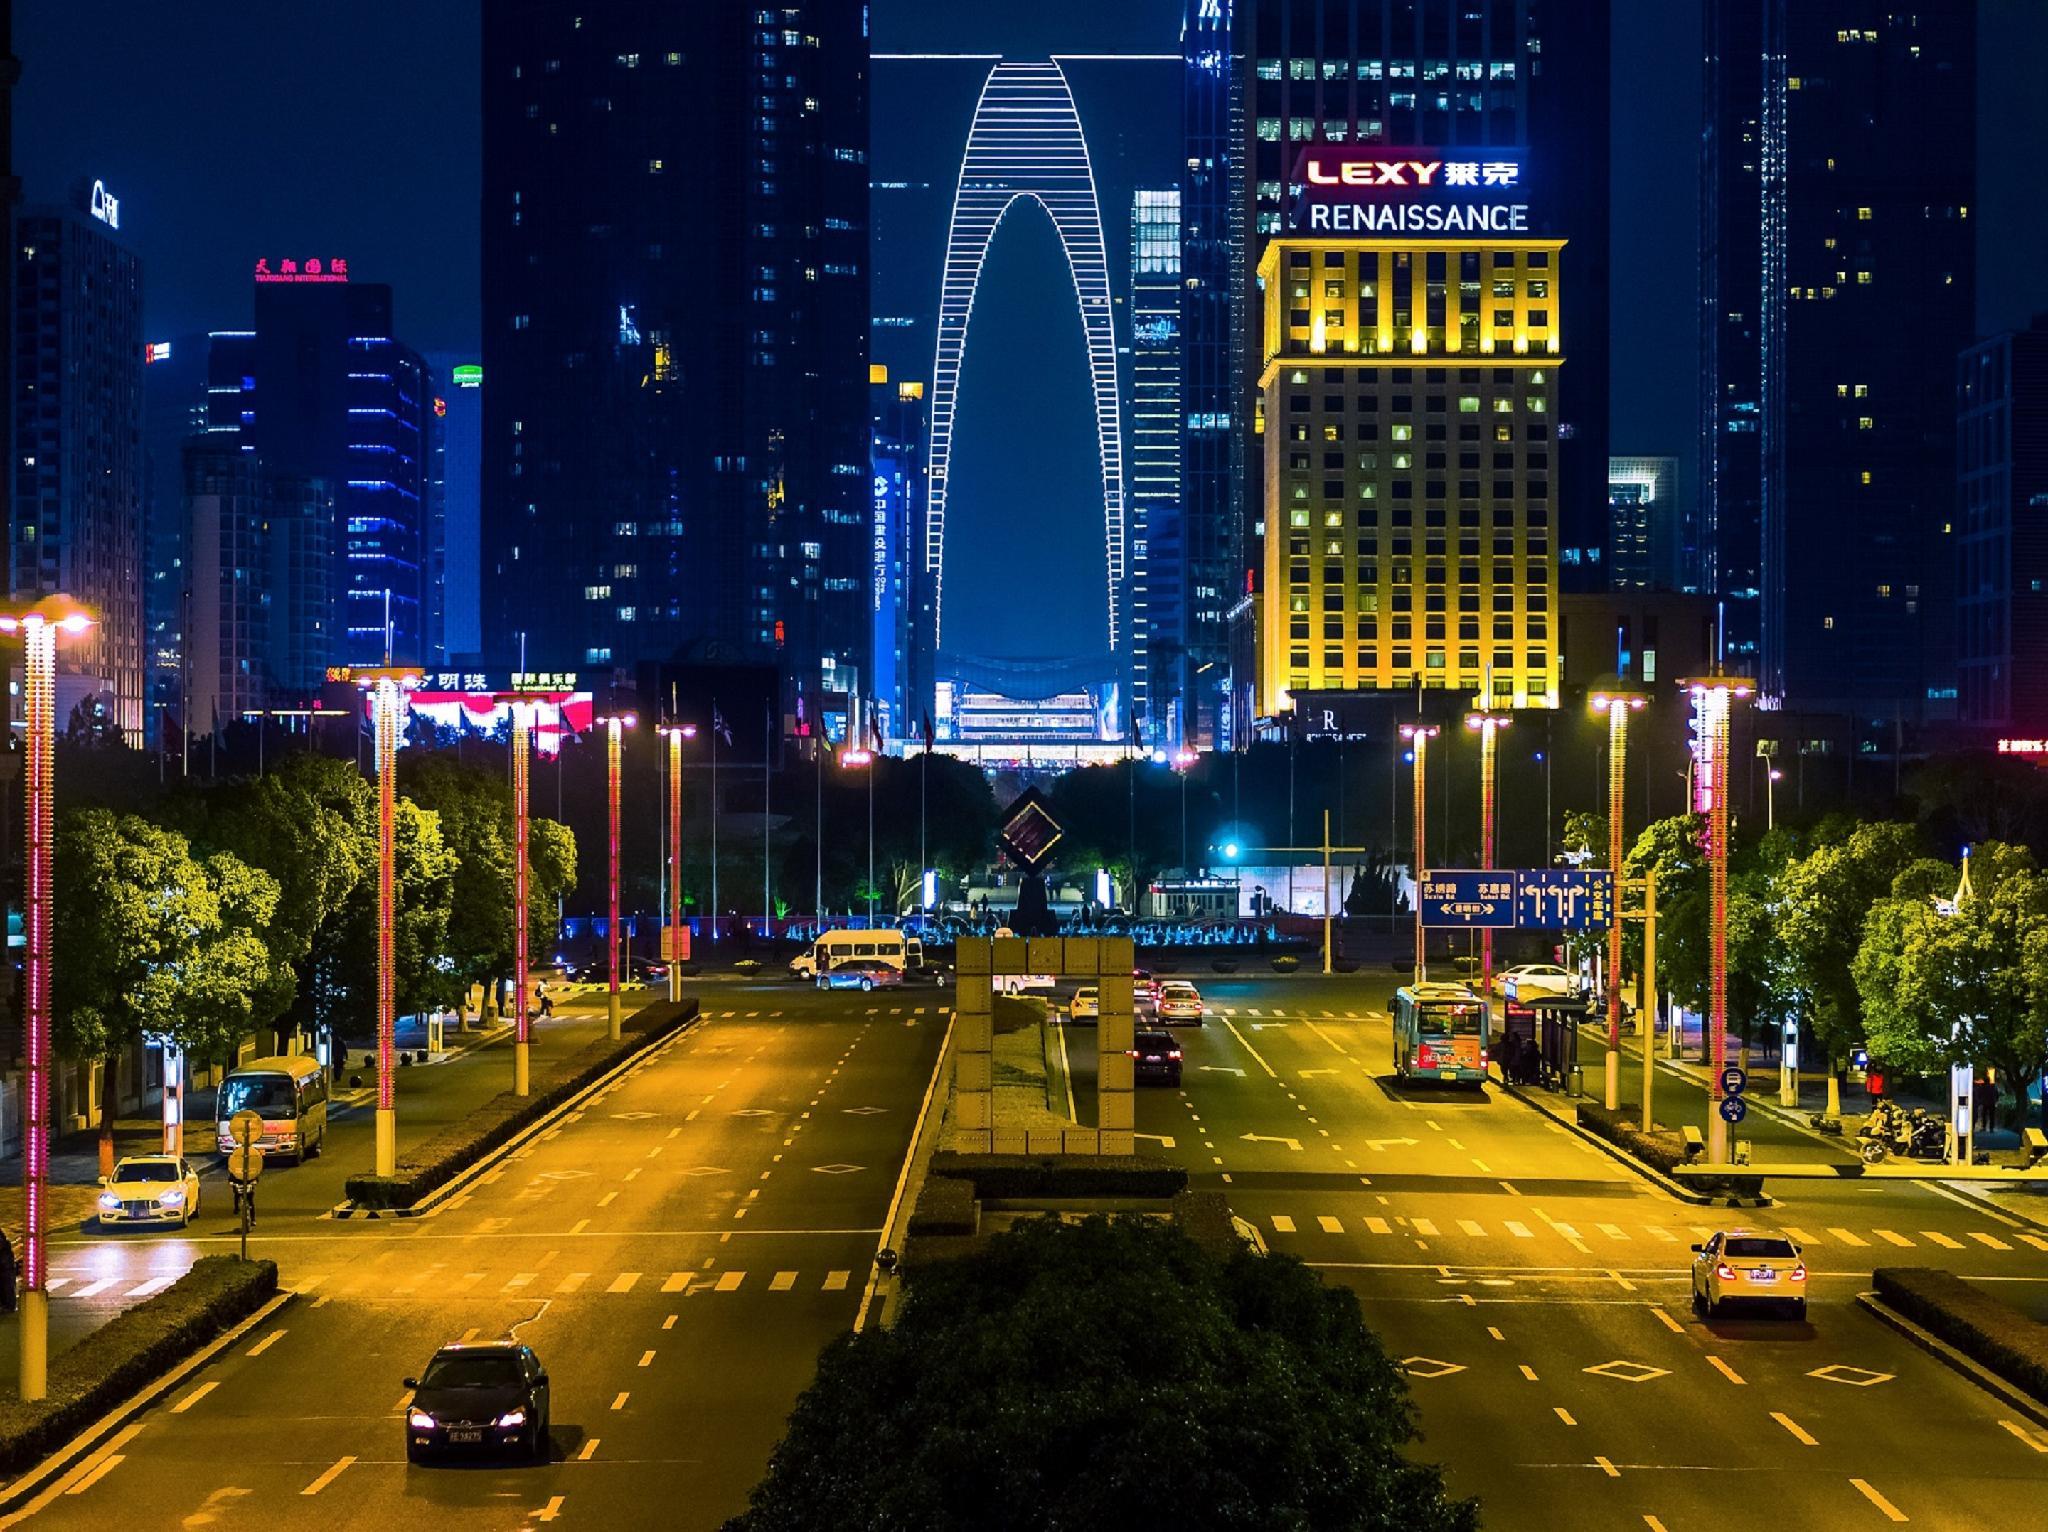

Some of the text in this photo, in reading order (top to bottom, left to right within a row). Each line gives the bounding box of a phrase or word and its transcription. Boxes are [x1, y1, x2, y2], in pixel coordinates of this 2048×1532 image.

[1307, 161, 1518, 186] LEXY 莱克
[1310, 204, 1528, 231] RENAISSANCE
[1322, 709, 1339, 730] R
